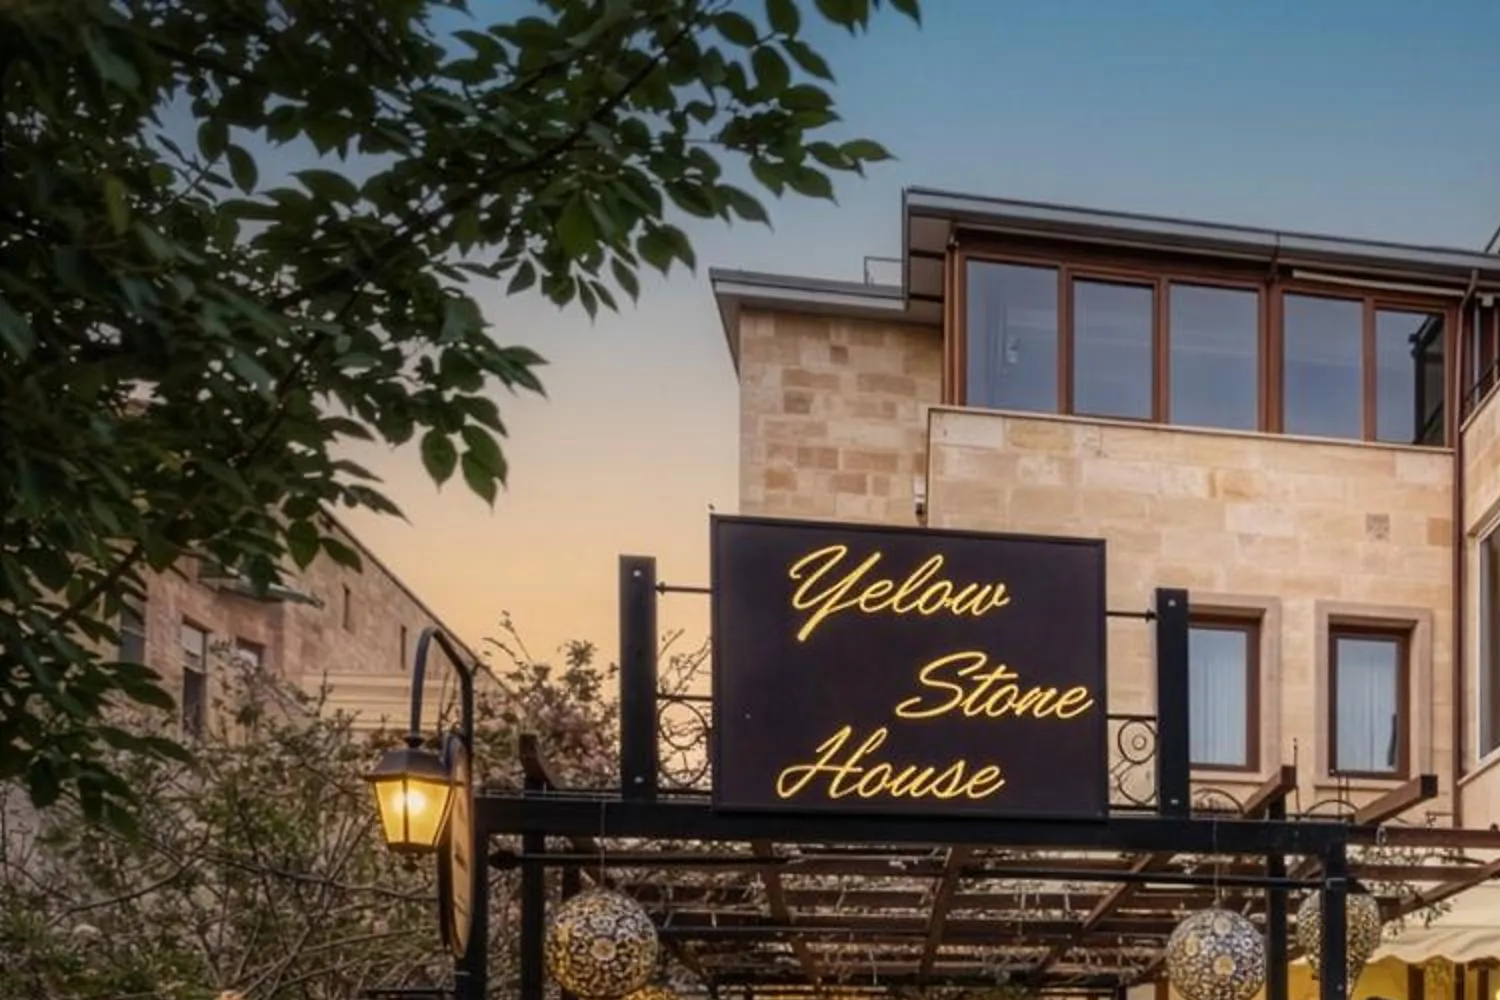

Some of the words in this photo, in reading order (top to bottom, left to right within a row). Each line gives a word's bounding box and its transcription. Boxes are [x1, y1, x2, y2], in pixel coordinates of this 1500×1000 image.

[788, 544, 1010, 642] Yelow
[895, 651, 1094, 718] Stone
[776, 725, 1005, 799] House
